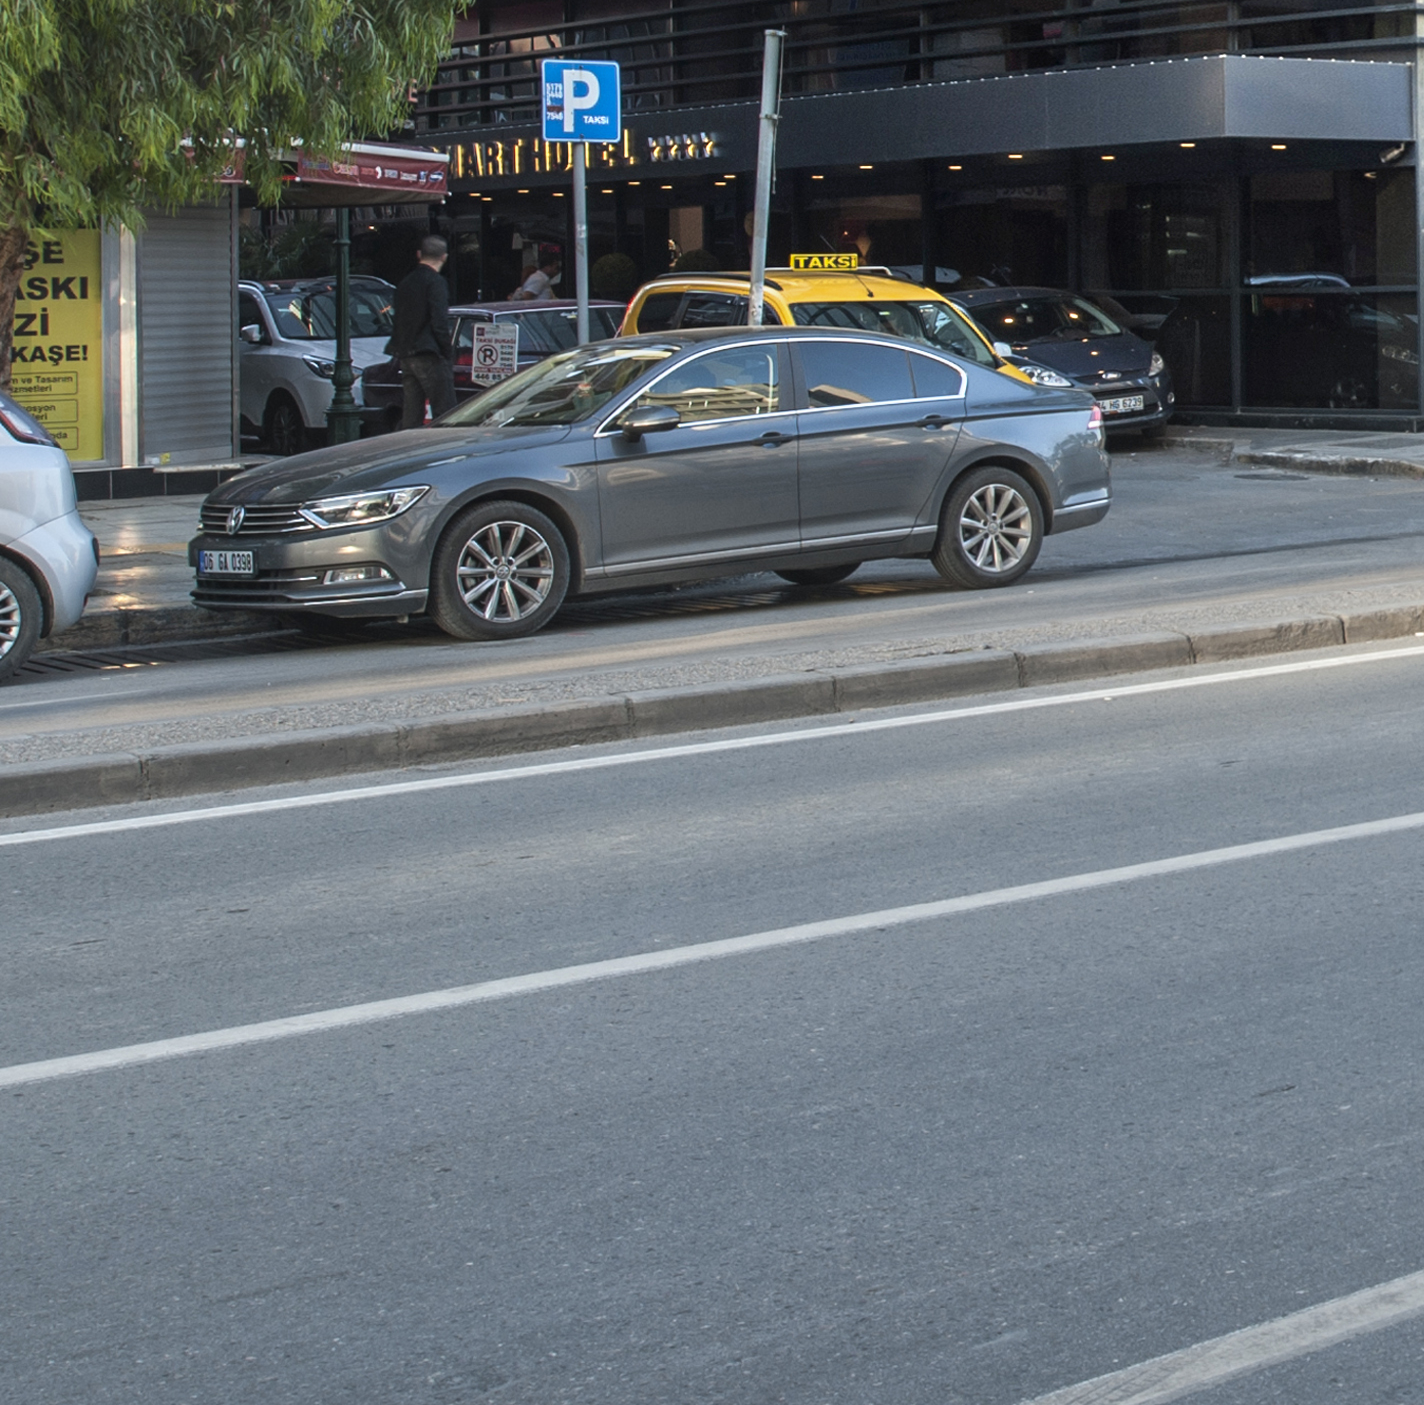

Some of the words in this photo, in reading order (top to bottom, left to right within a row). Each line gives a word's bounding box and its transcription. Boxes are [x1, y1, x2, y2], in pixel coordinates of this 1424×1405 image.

[447, 138, 524, 179] MART
[23, 240, 64, 270] ŞE
[794, 256, 857, 268] TAKSİ
[14, 308, 50, 337] Zİ
[204, 552, 214, 571] 06
[232, 552, 252, 572] 0398
